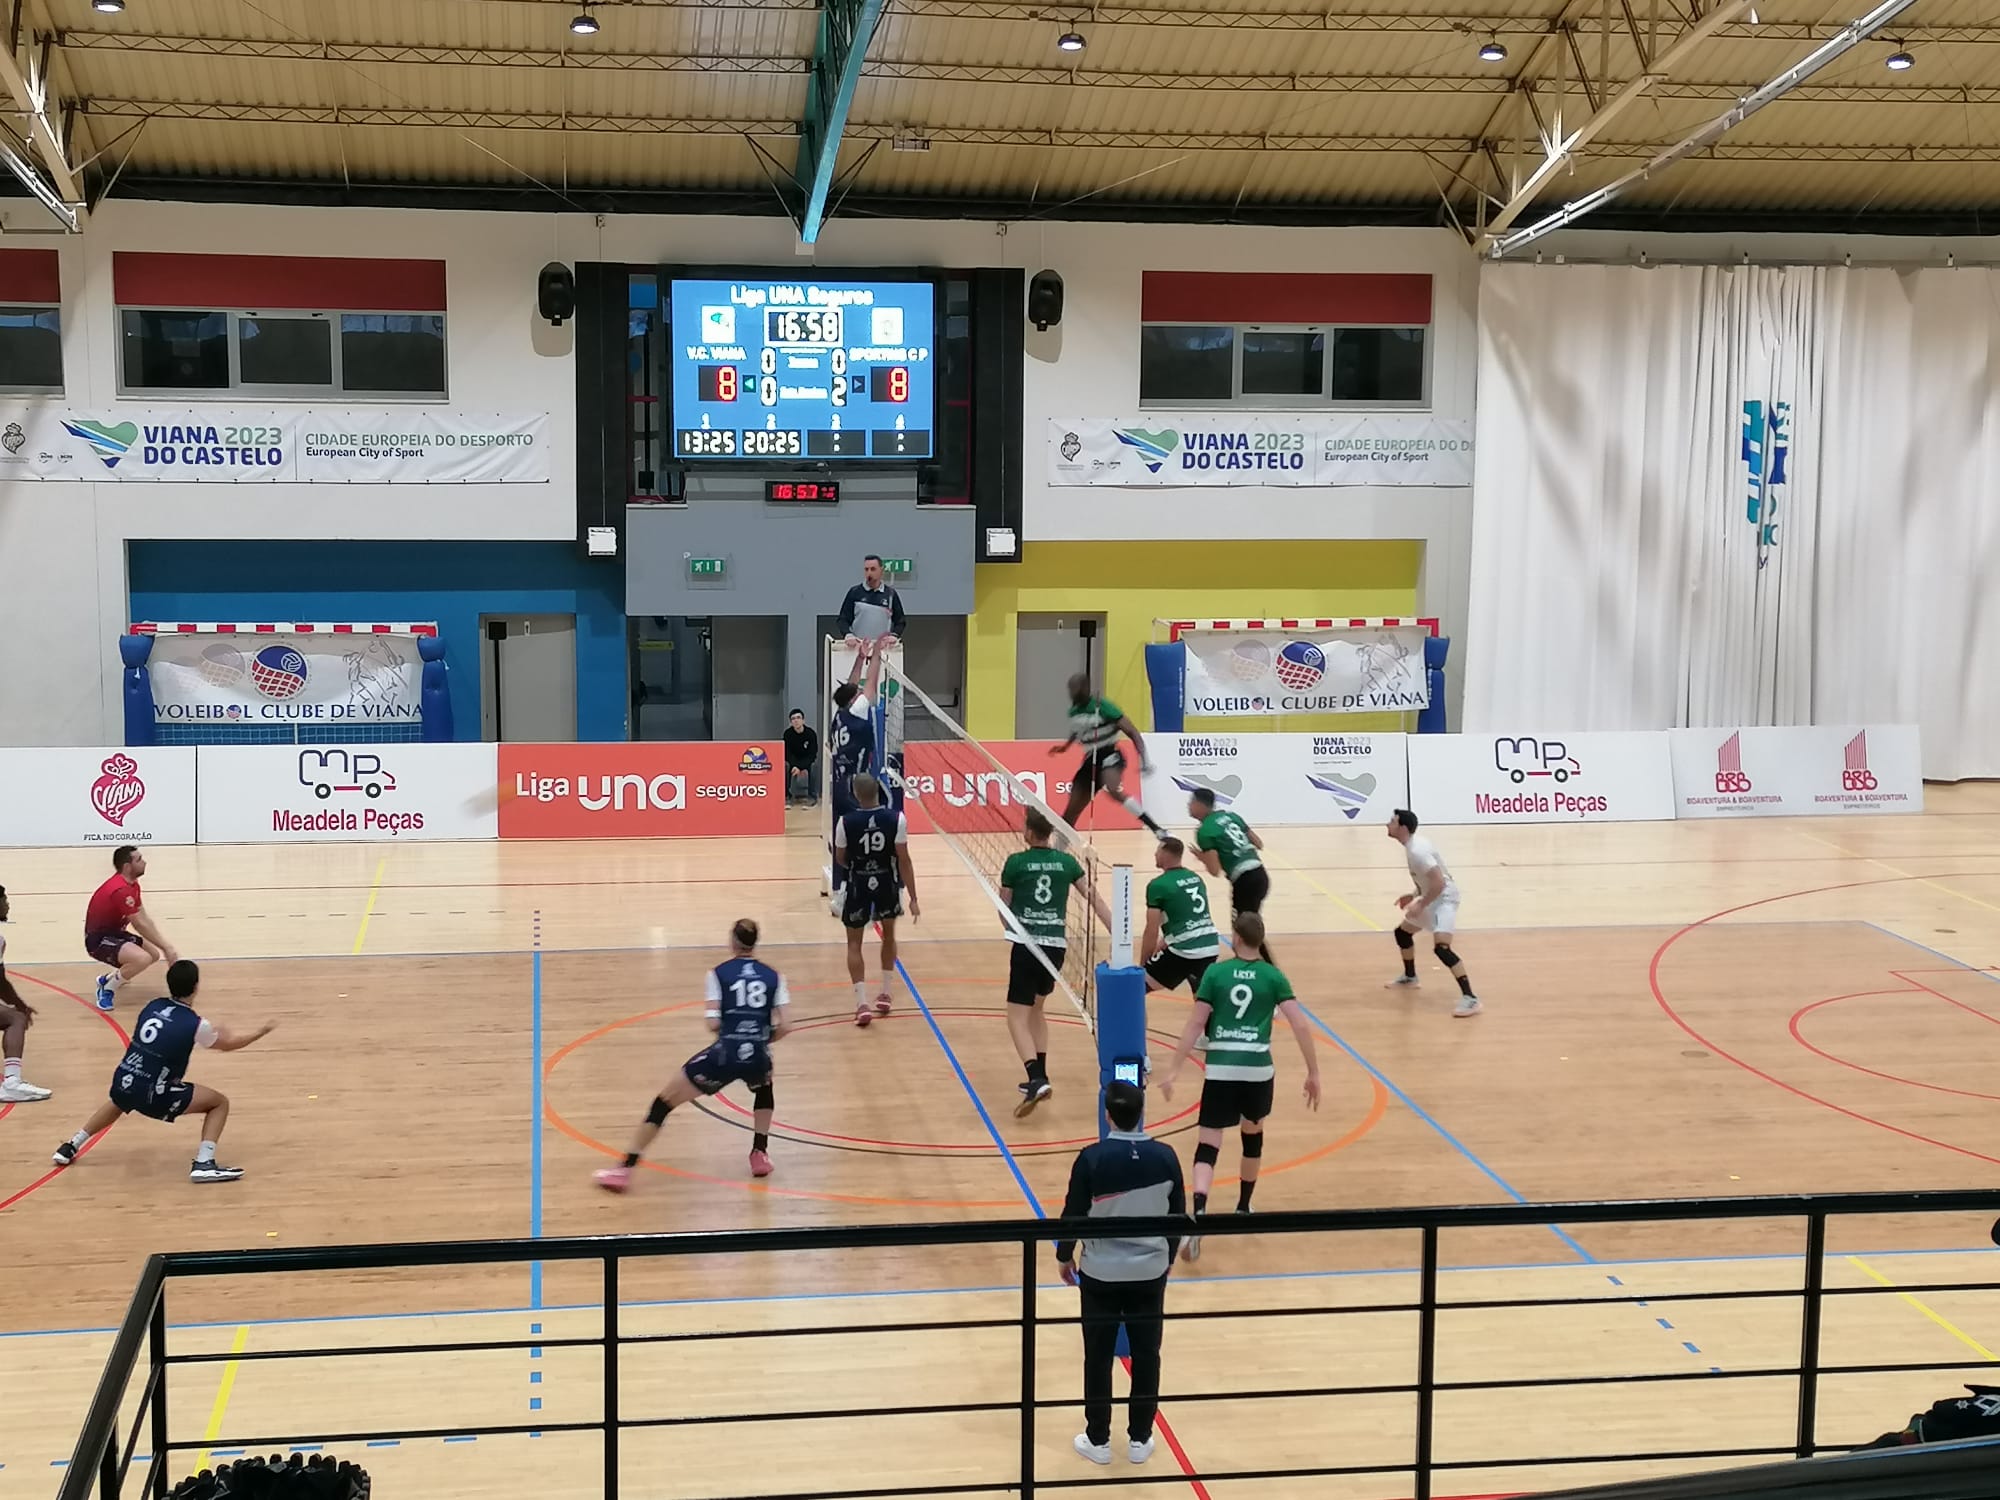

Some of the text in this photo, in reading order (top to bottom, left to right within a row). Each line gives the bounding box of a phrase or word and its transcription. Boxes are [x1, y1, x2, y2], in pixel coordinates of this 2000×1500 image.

[778, 311, 838, 341] 16:58
[761, 348, 776, 374] 0
[832, 348, 846, 374] 0
[718, 366, 737, 401] 8
[761, 376, 777, 406] 0
[832, 376, 847, 406] 2
[889, 367, 908, 402] 8
[701, 413, 711, 429] 1
[895, 414, 905, 429] 4
[143, 426, 282, 445] VIANA 2023
[305, 433, 533, 446] CIDADE EUROPEIA DO DESPORTO
[684, 431, 736, 454] 13:25
[744, 431, 800, 454] 20:25
[1183, 433, 1304, 450] VIANA 2023
[1325, 439, 1371, 450] CIDADE
[1374, 440, 1436, 450] EUROPEIA
[1439, 440, 1457, 451] DO
[144, 447, 282, 465] DO CASTELO
[306, 447, 424, 460] European City of Sport
[1182, 452, 1304, 469] DO CASTELO
[1325, 451, 1429, 463] European City of Sport
[154, 704, 422, 719] VOLEIBOL CLUBE DE VIANA
[1193, 691, 1425, 711] VOLEIBOL CLUBE DE VIANA
[1178, 738, 1211, 747] VIANA
[1178, 747, 1238, 757] DO CASTELO
[1313, 737, 1345, 746] VIANA
[1313, 746, 1372, 755] DO CASTELO
[516, 772, 767, 810] Liga una seguros
[904, 775, 936, 799] ga
[943, 770, 1047, 807] una
[1475, 791, 1608, 817] Meadela Peças
[273, 808, 424, 835] Meadela Peças
[83, 831, 153, 842] FICA NO CORAÇÃO
[859, 831, 886, 855] 19
[1034, 874, 1052, 904] 8
[1185, 886, 1206, 914] 3
[729, 979, 767, 1008] 18
[1230, 984, 1252, 1019] 9
[139, 1018, 163, 1043] 6
